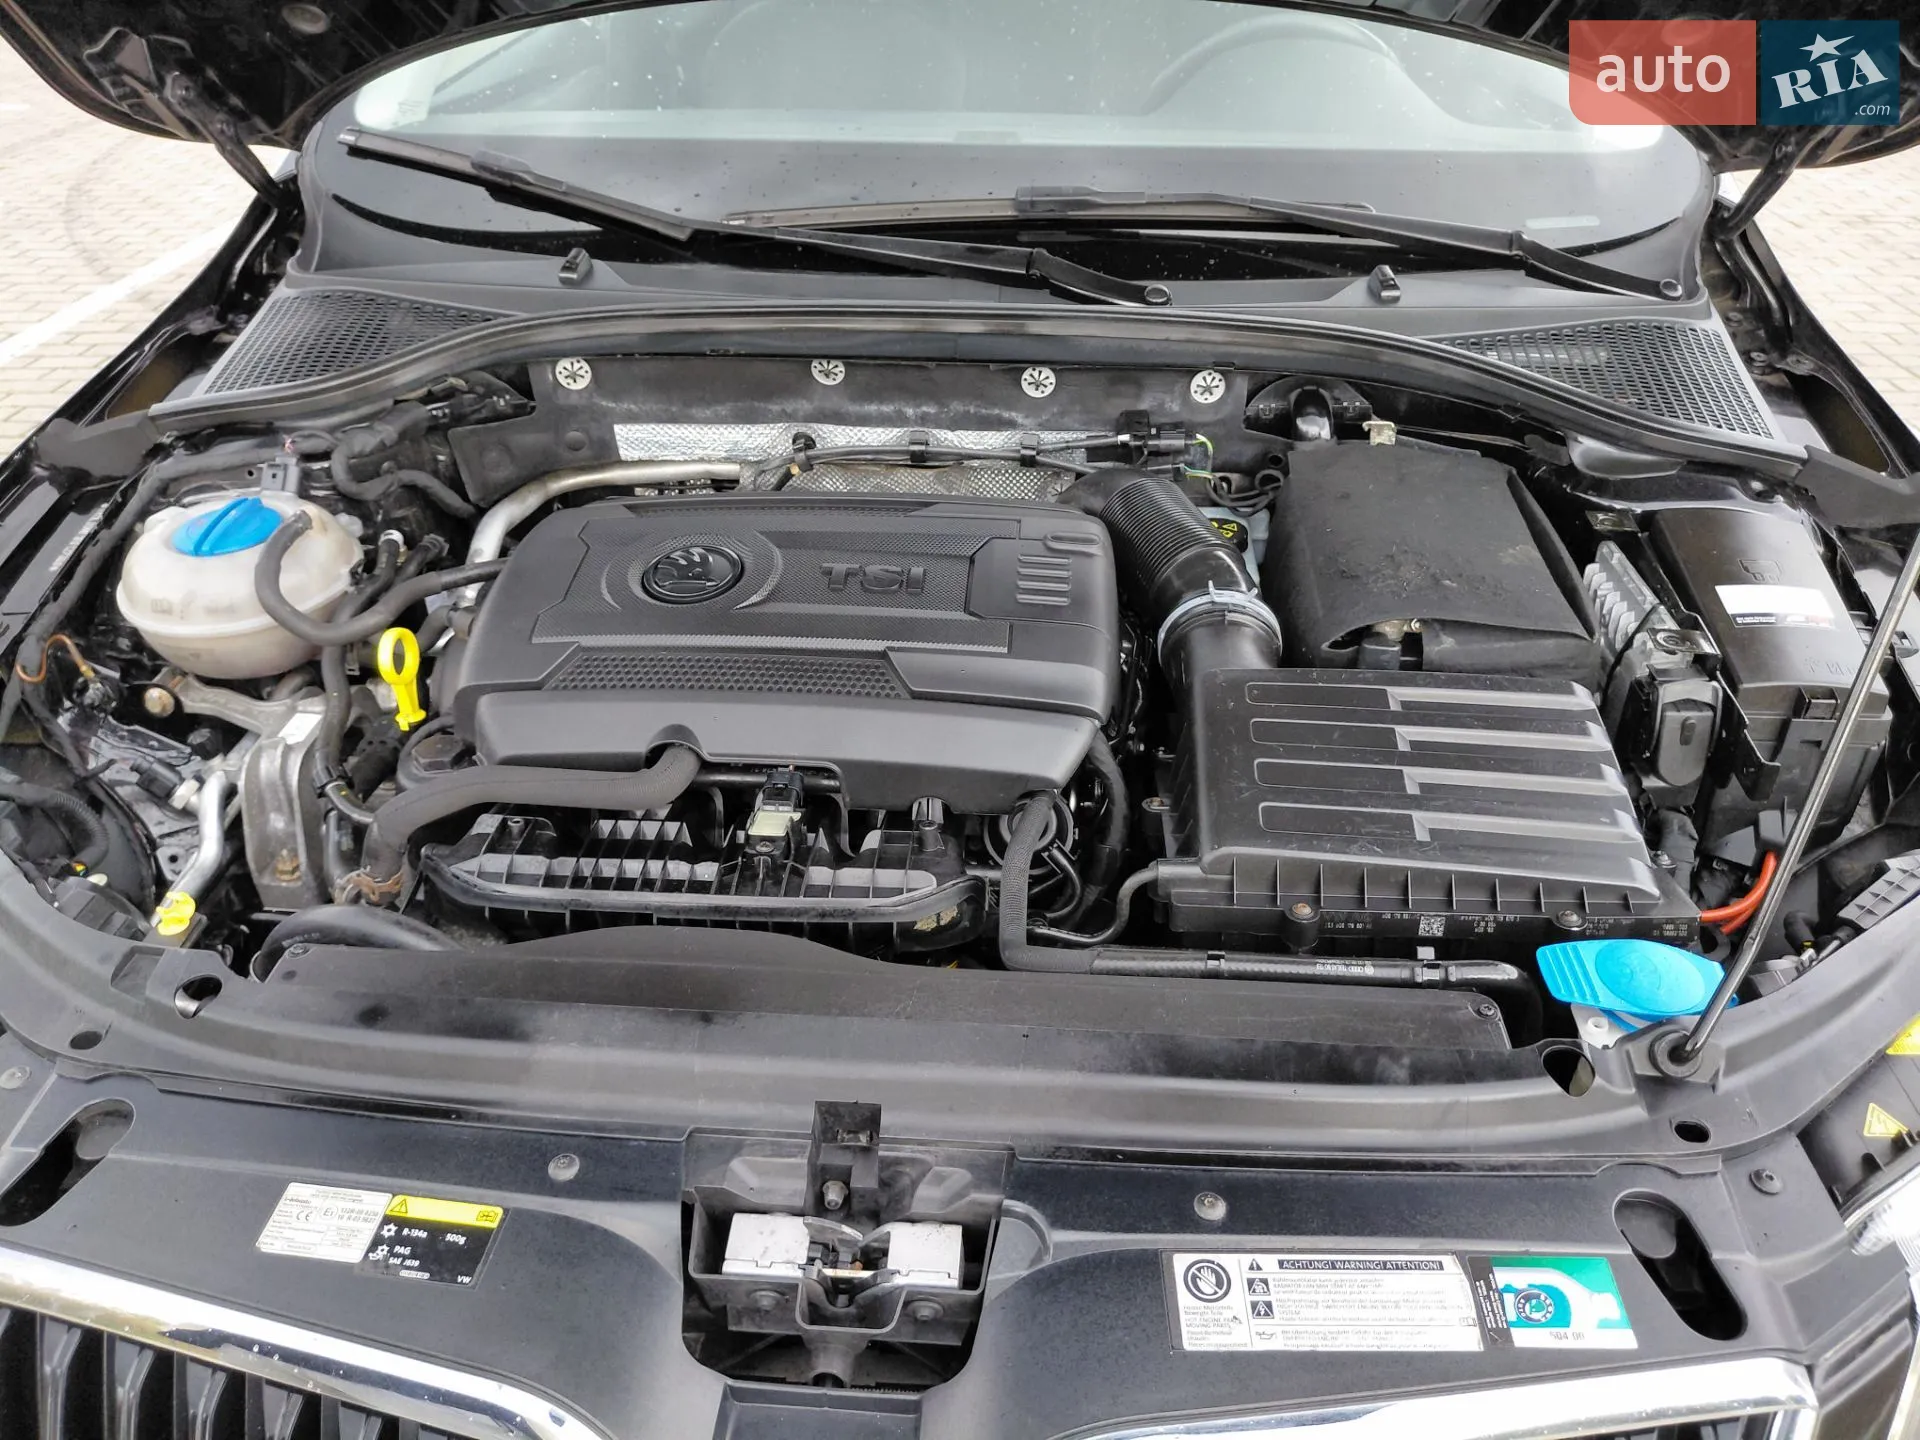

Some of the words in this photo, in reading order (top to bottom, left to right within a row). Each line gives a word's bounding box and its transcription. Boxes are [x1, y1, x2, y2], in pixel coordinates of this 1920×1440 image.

[821, 564, 924, 595] TSI
[402, 1228, 428, 1239] R-134a
[445, 1232, 467, 1245] 500g
[393, 1245, 412, 1255] PAG
[388, 1257, 403, 1265] SAE
[403, 1259, 420, 1267] J639
[1282, 1260, 1332, 1269] ACHTUNG!
[1334, 1260, 1384, 1270] WARNING!
[1386, 1260, 1440, 1270] ATTENTION!
[457, 1275, 472, 1284] VW
